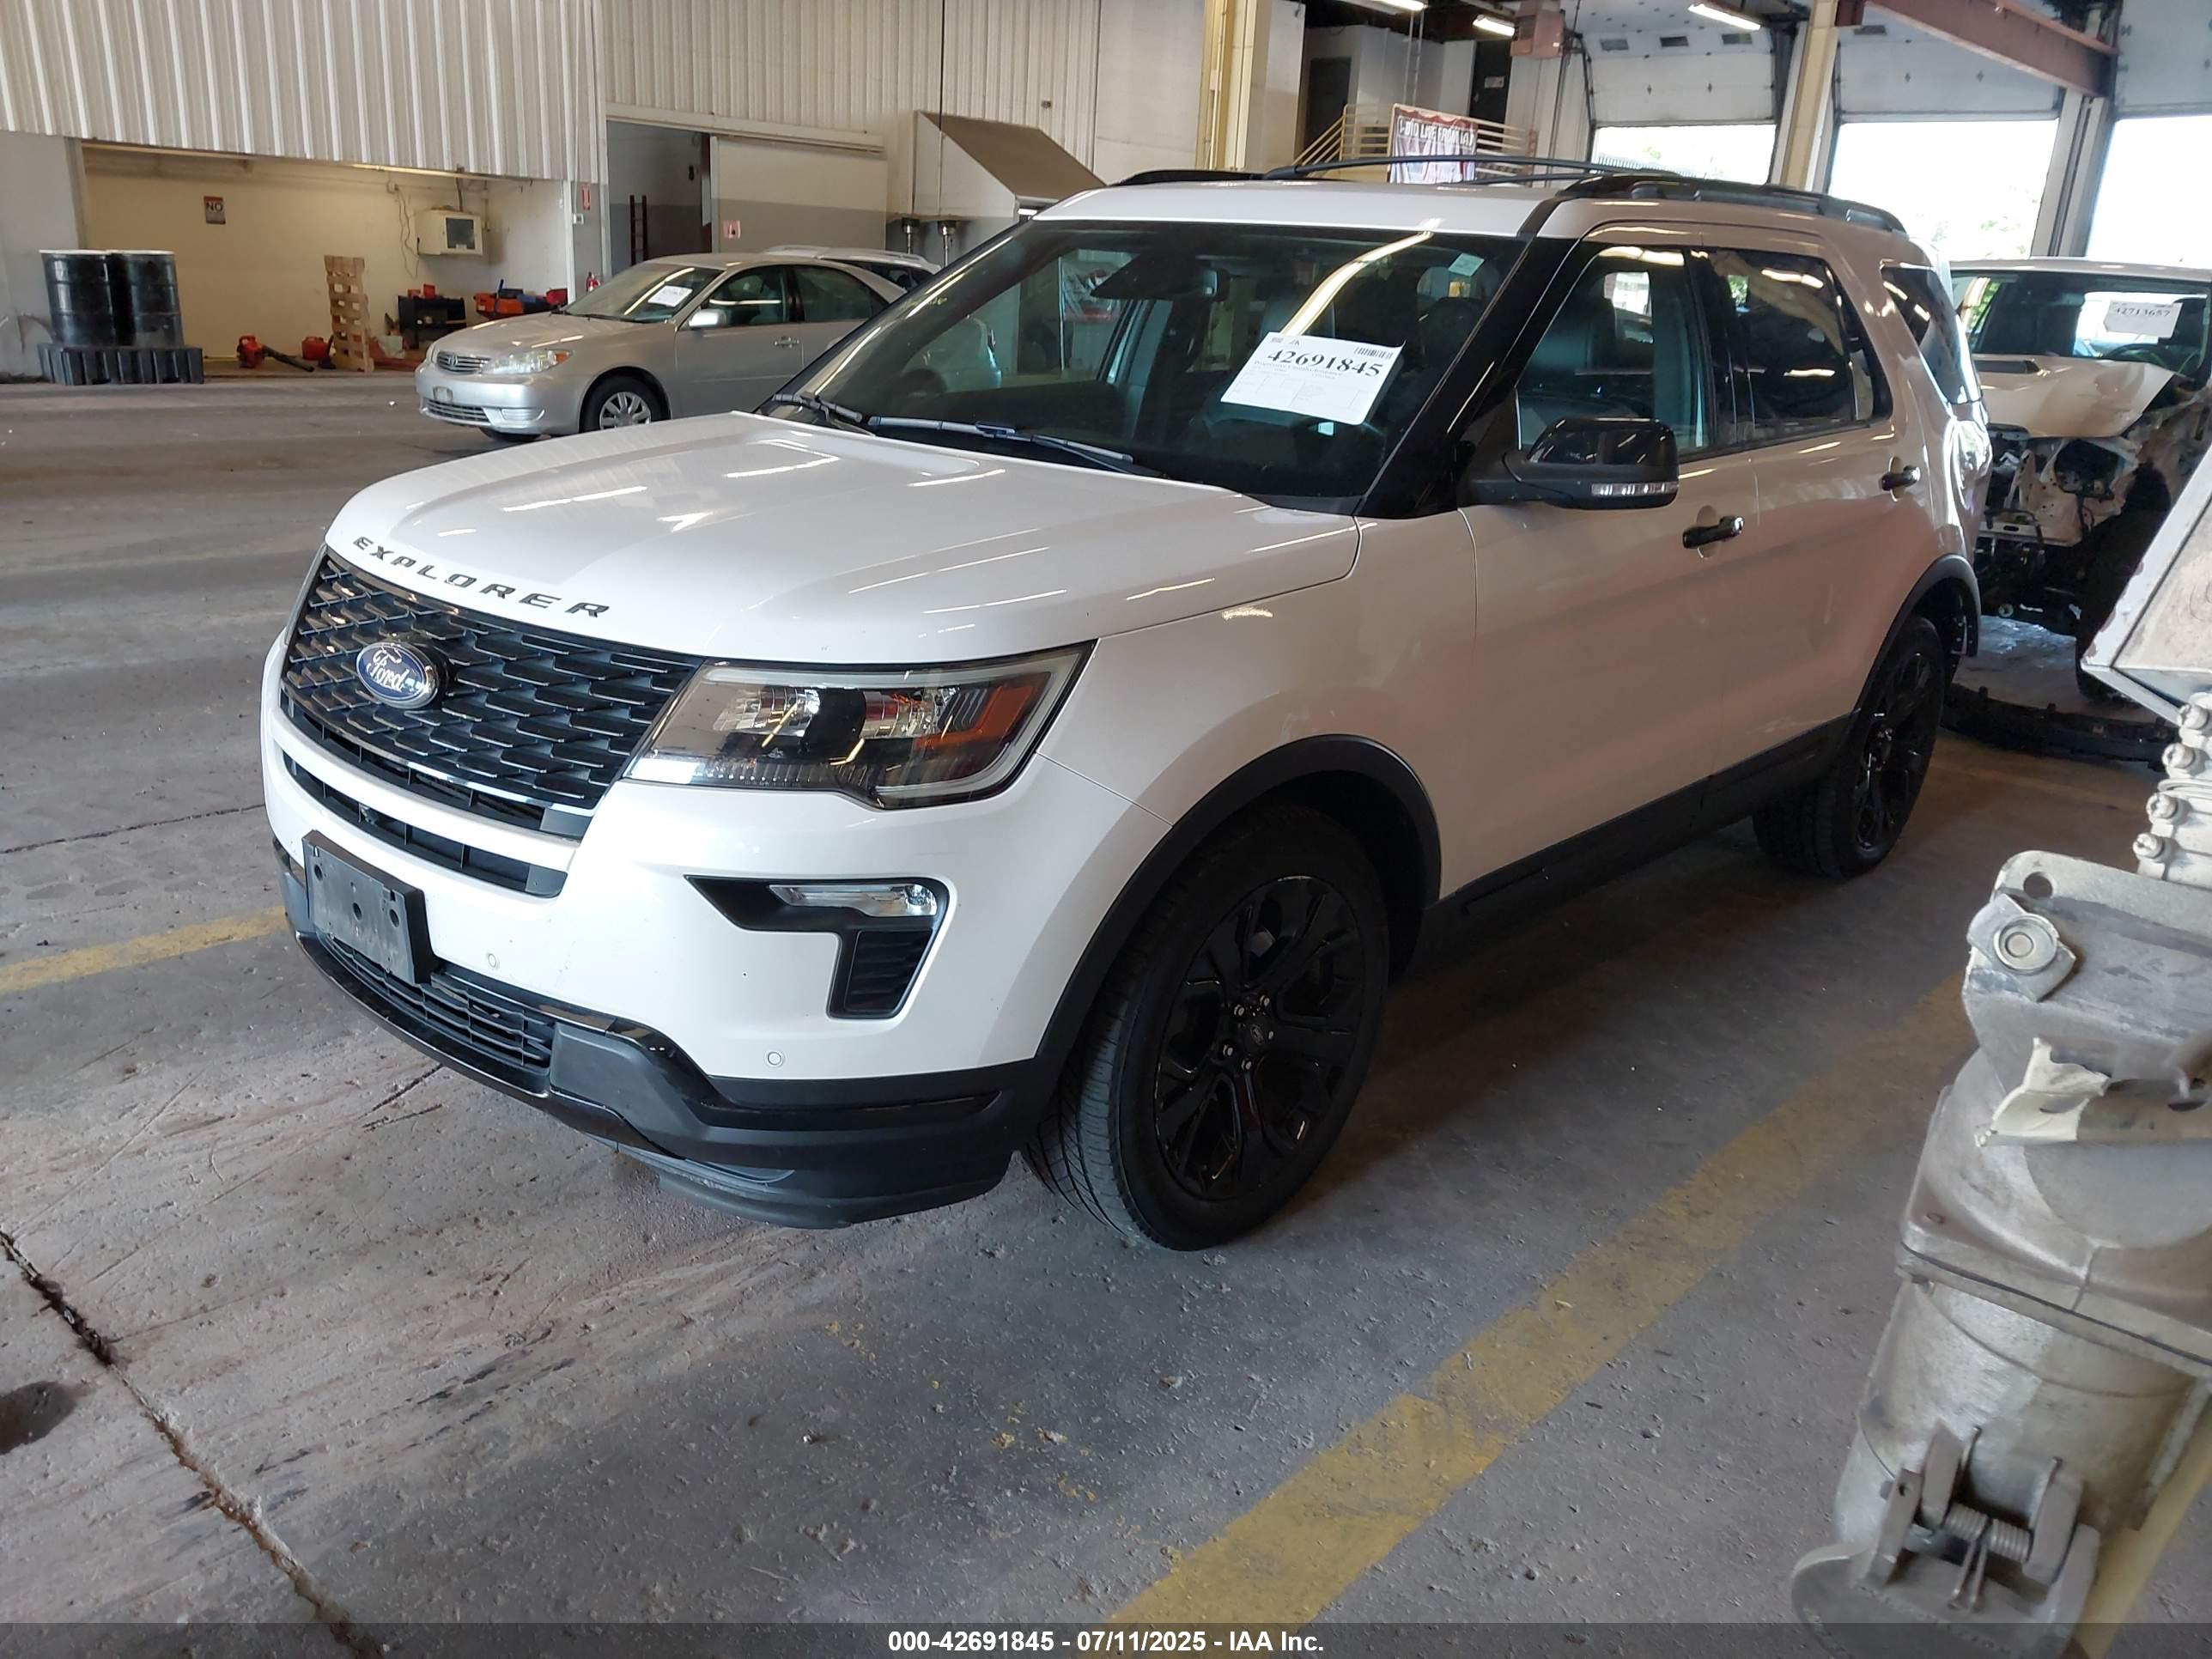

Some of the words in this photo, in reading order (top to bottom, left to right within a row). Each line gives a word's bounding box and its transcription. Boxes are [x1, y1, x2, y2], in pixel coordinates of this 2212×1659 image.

[1267, 349, 1384, 378] 42691845
[353, 536, 610, 618] EXPLORER
[366, 645, 410, 693] Ford
